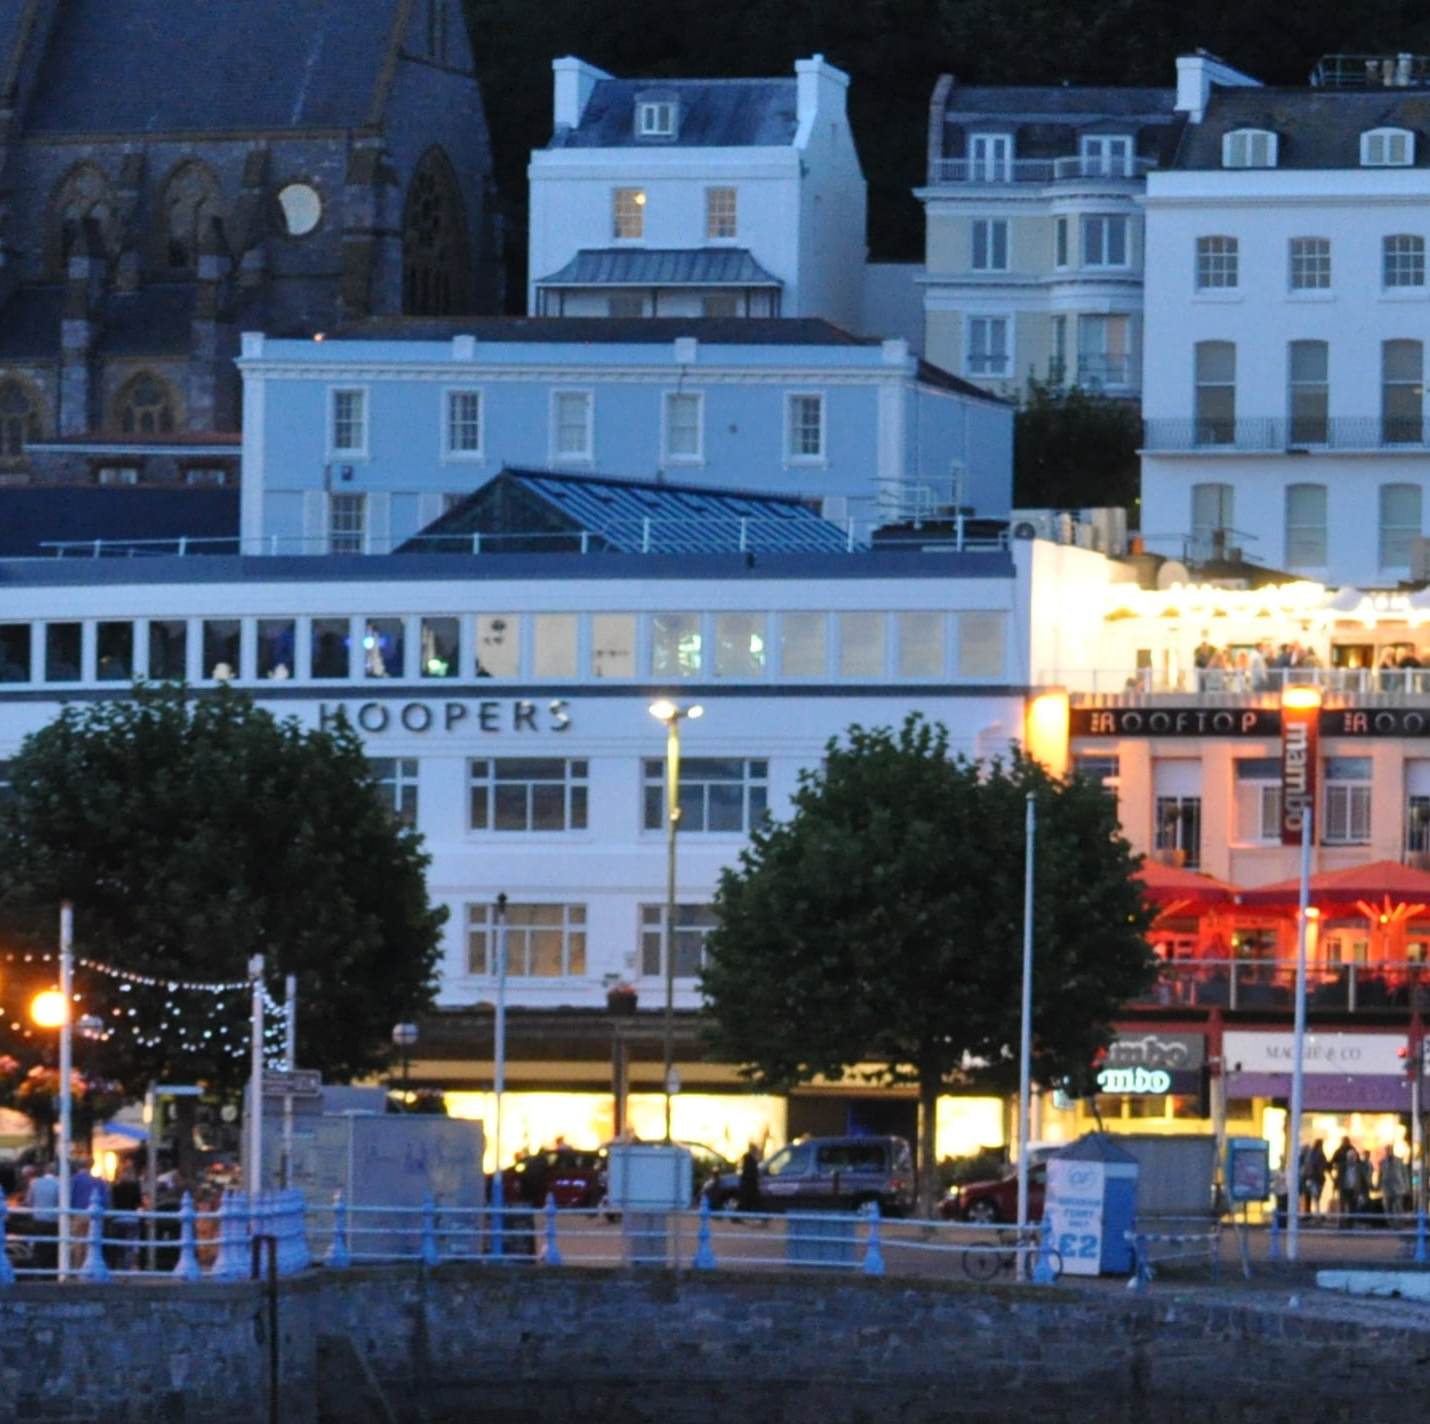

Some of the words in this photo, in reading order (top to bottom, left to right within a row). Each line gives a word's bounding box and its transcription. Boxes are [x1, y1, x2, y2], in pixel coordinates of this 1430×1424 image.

[319, 702, 570, 732] HOOPERS
[1100, 712, 1258, 733] ROOFTOP
[1285, 722, 1312, 831] mambo
[1266, 1046, 1322, 1060] MAIE
[1057, 1233, 1099, 1259] £2
